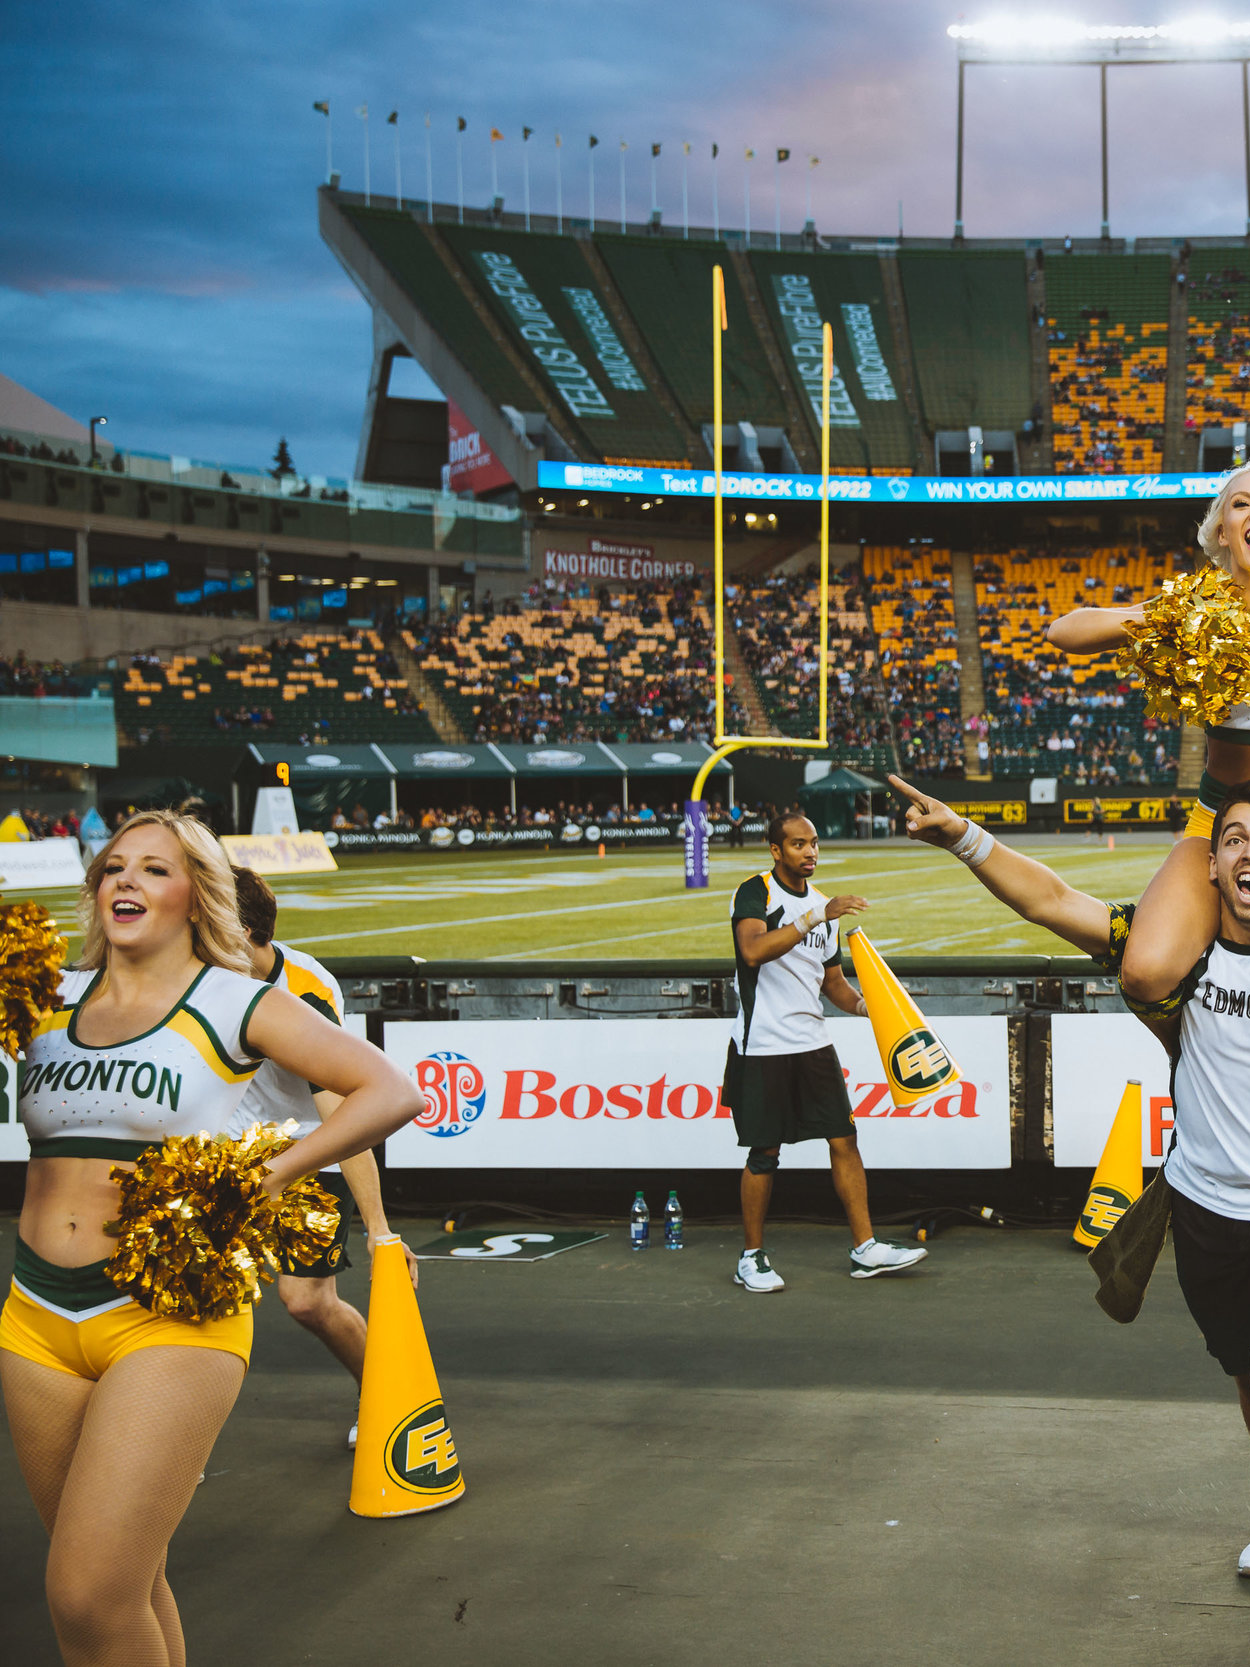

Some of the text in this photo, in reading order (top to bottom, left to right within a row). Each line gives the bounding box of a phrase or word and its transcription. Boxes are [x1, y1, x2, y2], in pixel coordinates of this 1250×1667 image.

[533, 346, 616, 417] TELUS
[797, 362, 861, 429] TELUS
[583, 466, 643, 482] BEDROCK
[661, 474, 698, 493] Text
[796, 482, 814, 497] to
[926, 482, 962, 499] WIN
[965, 481, 1014, 499] YOUR
[1016, 481, 1062, 498] OWN
[1064, 480, 1129, 497] SMART
[1181, 477, 1224, 496] TEC
[546, 550, 695, 579] KNOTHOLE CORNER
[276, 762, 290, 787] 9
[1002, 803, 1024, 823] 63
[1139, 800, 1160, 820] 67
[341, 832, 421, 844] KONICA MINOLTA
[513, 829, 554, 840] MINOLTA
[602, 826, 671, 838] KONICA MINOLTA
[20, 1059, 183, 1113] DMONTON
[450, 1233, 555, 1257] S
